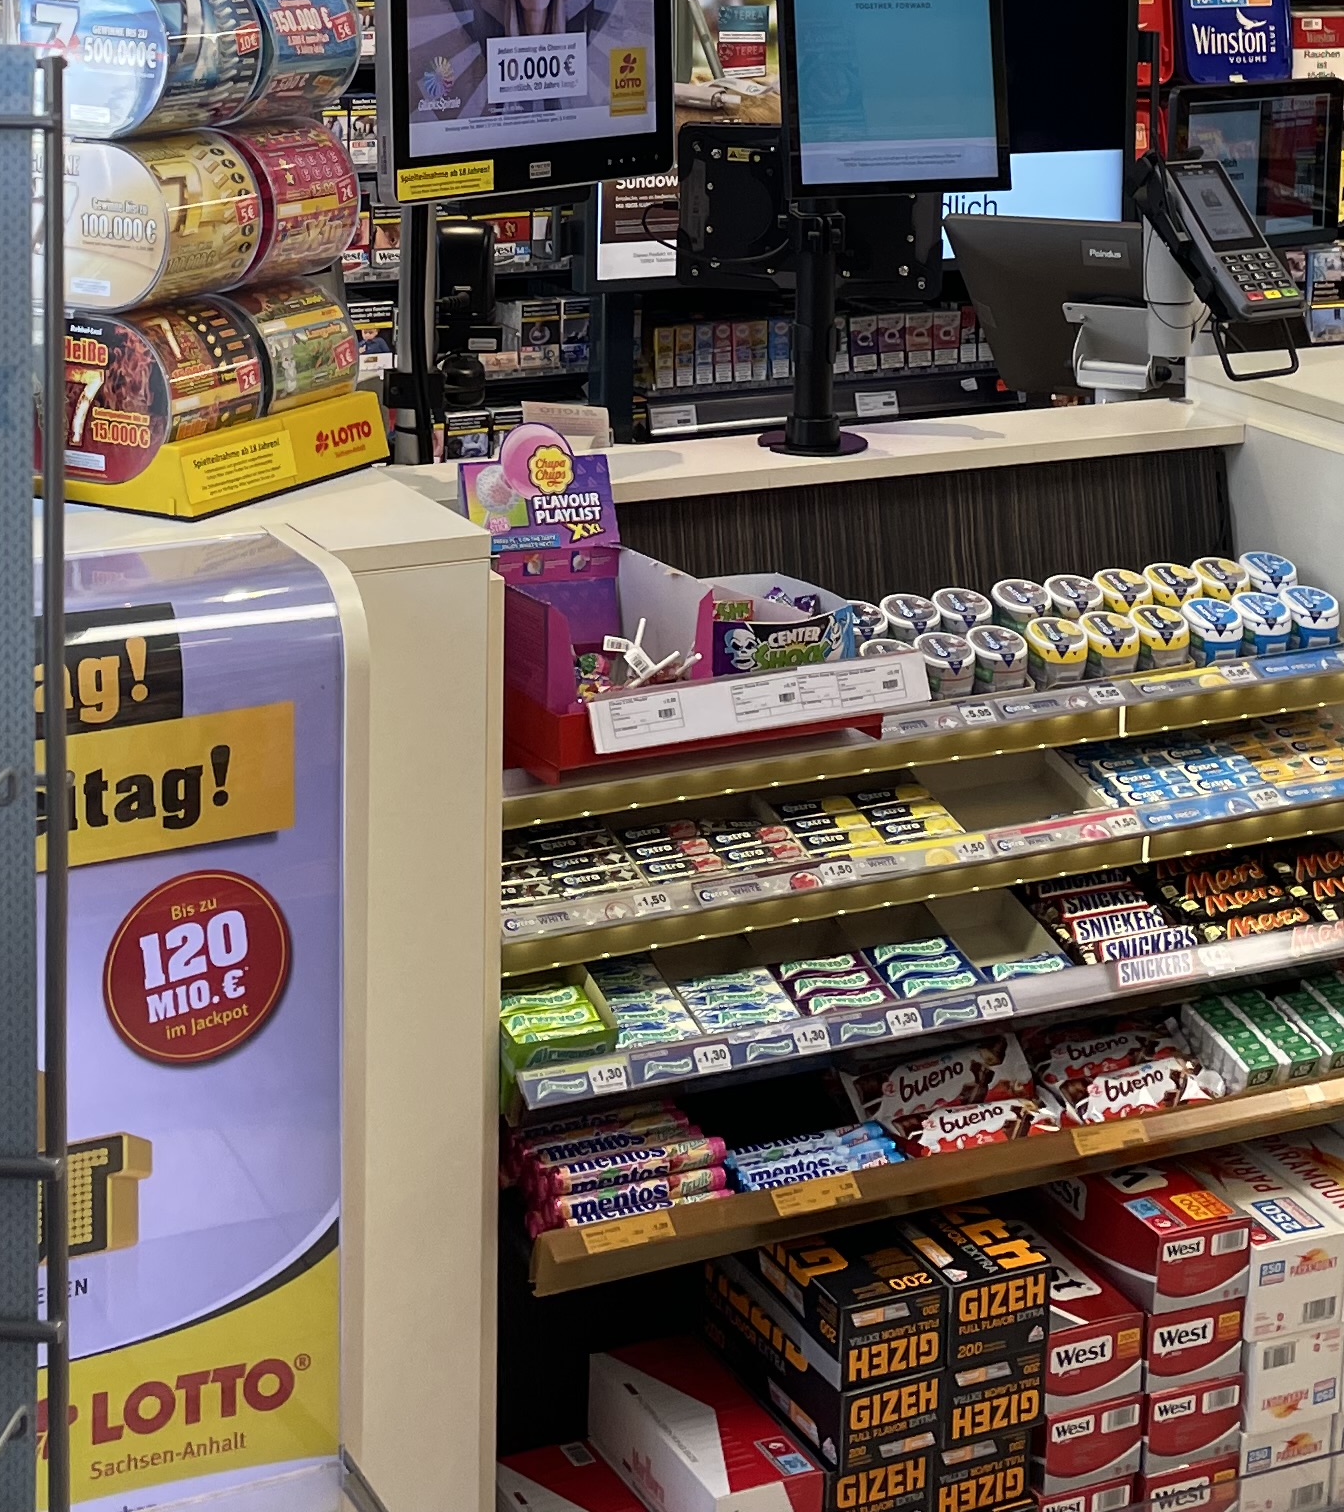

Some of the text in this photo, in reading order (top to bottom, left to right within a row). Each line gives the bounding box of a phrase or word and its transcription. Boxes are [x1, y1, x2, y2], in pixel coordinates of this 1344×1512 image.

[84, 36, 157, 69] 500.000€
[1192, 23, 1267, 55] Winston
[498, 54, 576, 82] 10.000 €
[1229, 55, 1267, 64] VOLUME
[615, 77, 641, 89] LOTTO
[81, 213, 156, 243] 100.000 €
[331, 421, 372, 447] LOTTO
[535, 456, 568, 472] Chupa
[535, 466, 568, 483] Chups
[533, 493, 601, 510] FLAVOUR
[535, 506, 602, 524] PLAYLIST
[567, 520, 605, 542] XXL
[767, 626, 821, 648] CENTER
[755, 639, 833, 671] SHOCK
[1185, 860, 1266, 896] Mars
[171, 898, 217, 921] Bis zu
[1076, 910, 1165, 941] SNICKERS
[140, 909, 248, 990] 120
[1106, 928, 1198, 959] SNICKERS
[795, 971, 870, 993] Airwaves
[146, 980, 220, 1024] MIO.
[166, 1003, 249, 1040] im Jackpot
[899, 1061, 964, 1102] bueno
[939, 1104, 1004, 1134] bueno
[571, 1185, 669, 1220] mentos
[958, 1274, 1046, 1323] GIZEH
[959, 1307, 1044, 1336] FULL FLAVOR EXTRA
[848, 1331, 939, 1383] GIZEH
[958, 1341, 983, 1358] 200
[849, 1378, 939, 1431] GIZEH
[952, 1389, 1040, 1440] GIZEH
[90, 1432, 247, 1480] Sachsen-Anhalt
